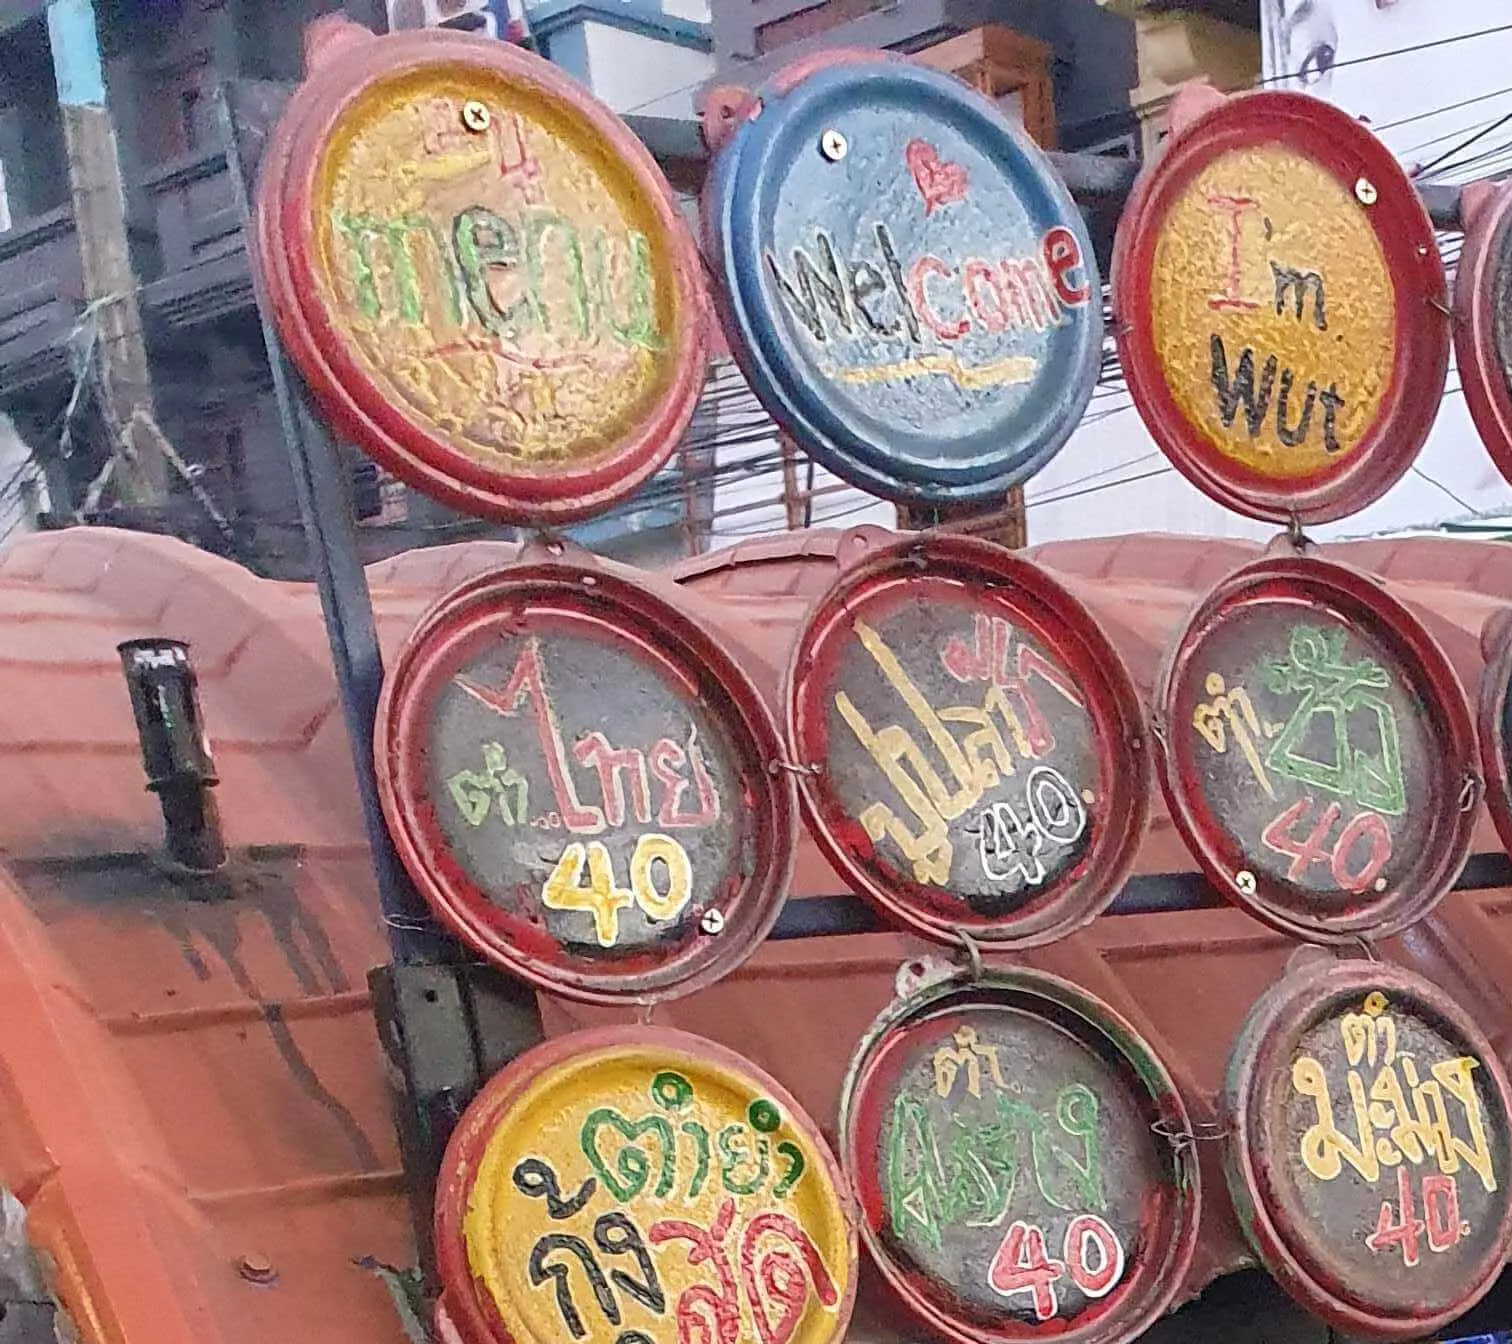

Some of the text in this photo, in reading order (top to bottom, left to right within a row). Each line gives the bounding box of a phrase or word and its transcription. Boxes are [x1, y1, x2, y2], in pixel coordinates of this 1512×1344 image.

[979, 766, 1086, 884] 40
[1262, 801, 1392, 893] 40
[542, 833, 691, 947] 40
[988, 1214, 1124, 1320] 40
